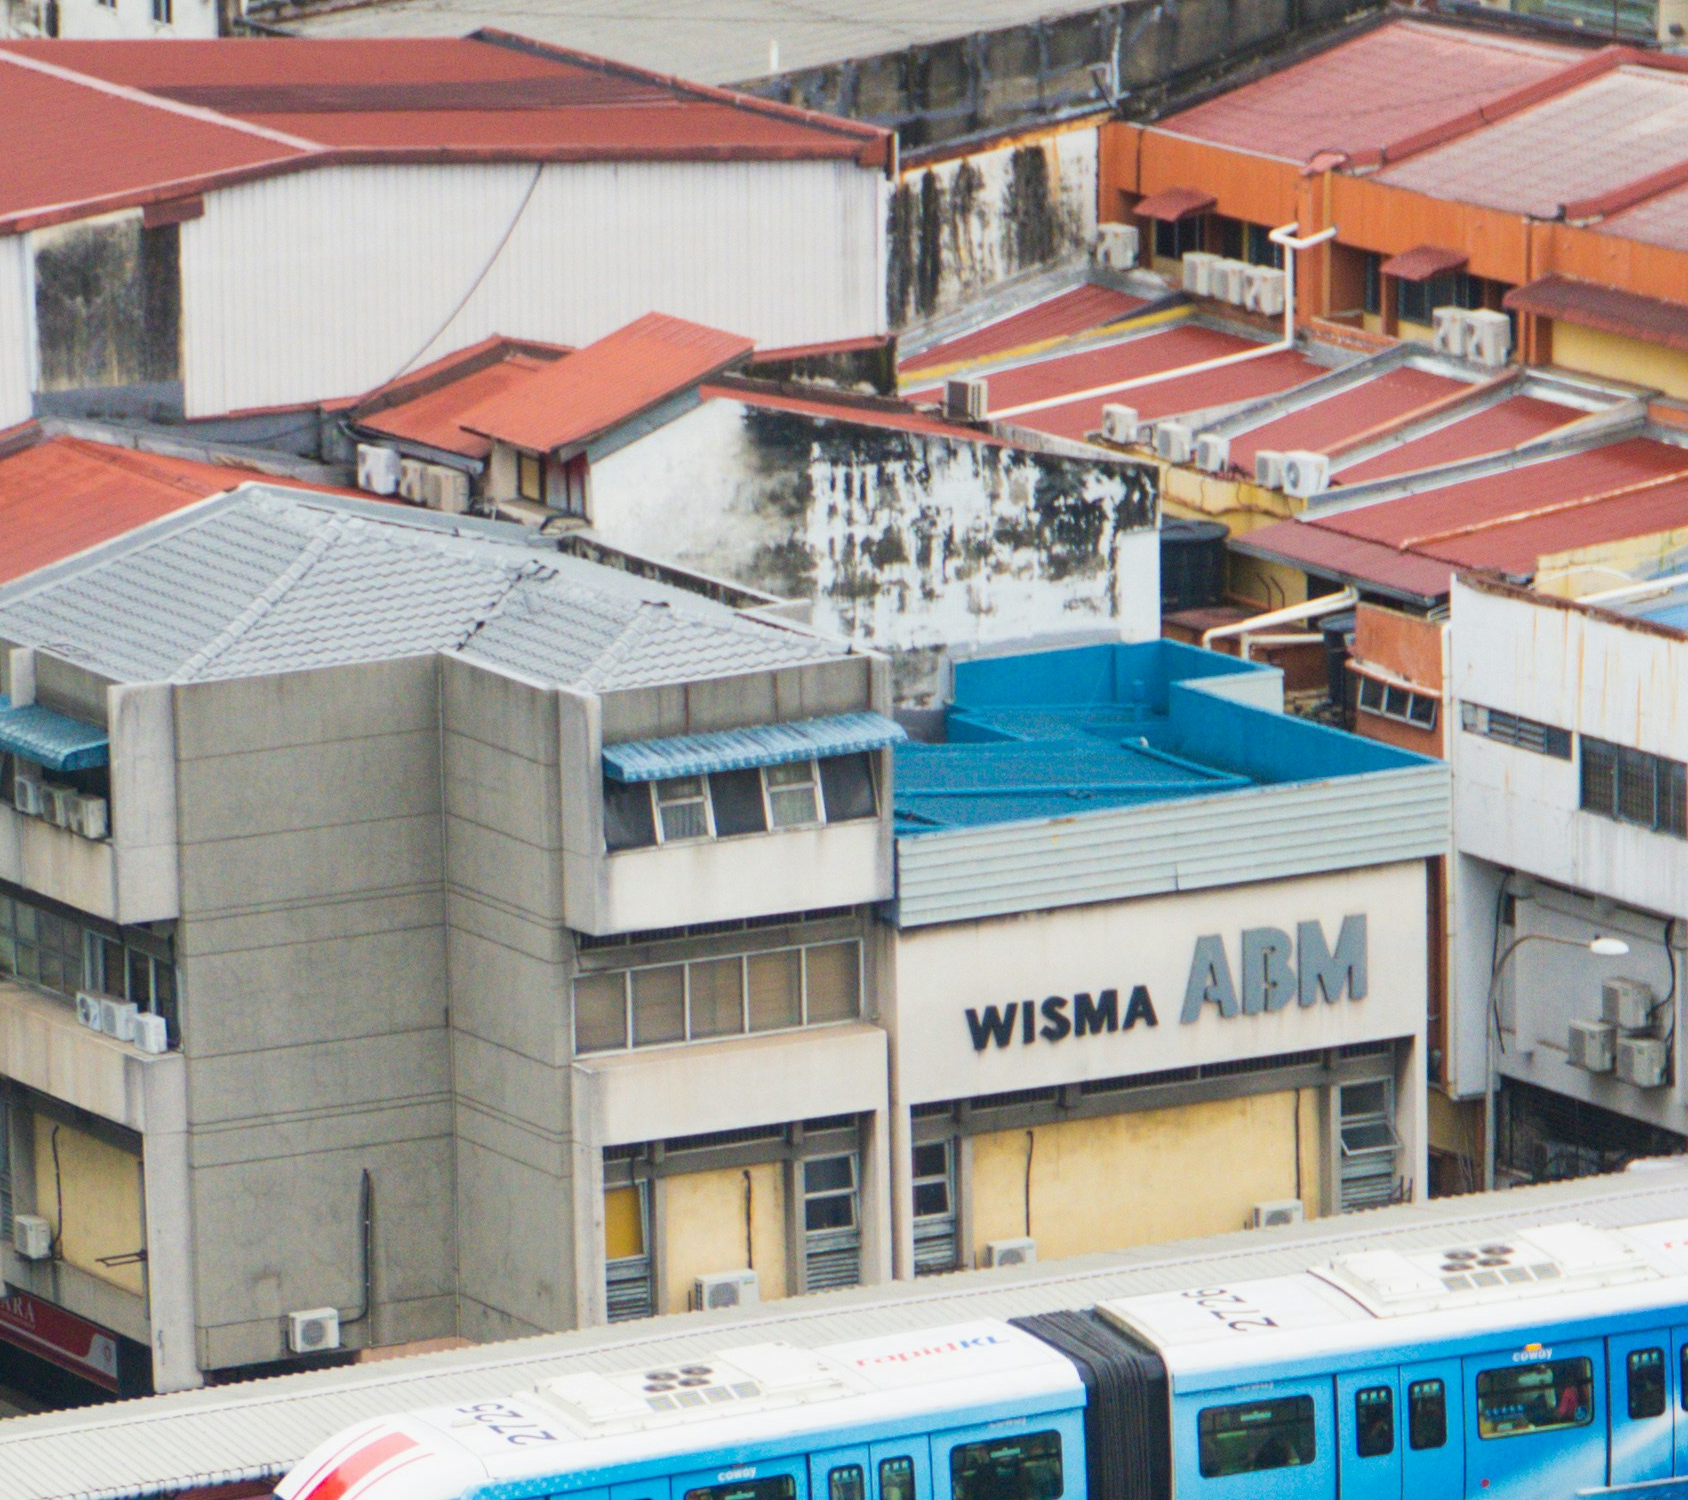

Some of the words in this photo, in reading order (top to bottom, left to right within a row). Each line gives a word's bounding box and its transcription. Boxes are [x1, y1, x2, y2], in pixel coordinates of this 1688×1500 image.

[965, 984, 1158, 1051] WISMA
[1180, 913, 1369, 1026] ABM
[1181, 1287, 1280, 1333] 2726
[855, 1335, 1011, 1368] rapidKL
[456, 1402, 559, 1446] 2725
[716, 1466, 757, 1483] coway
